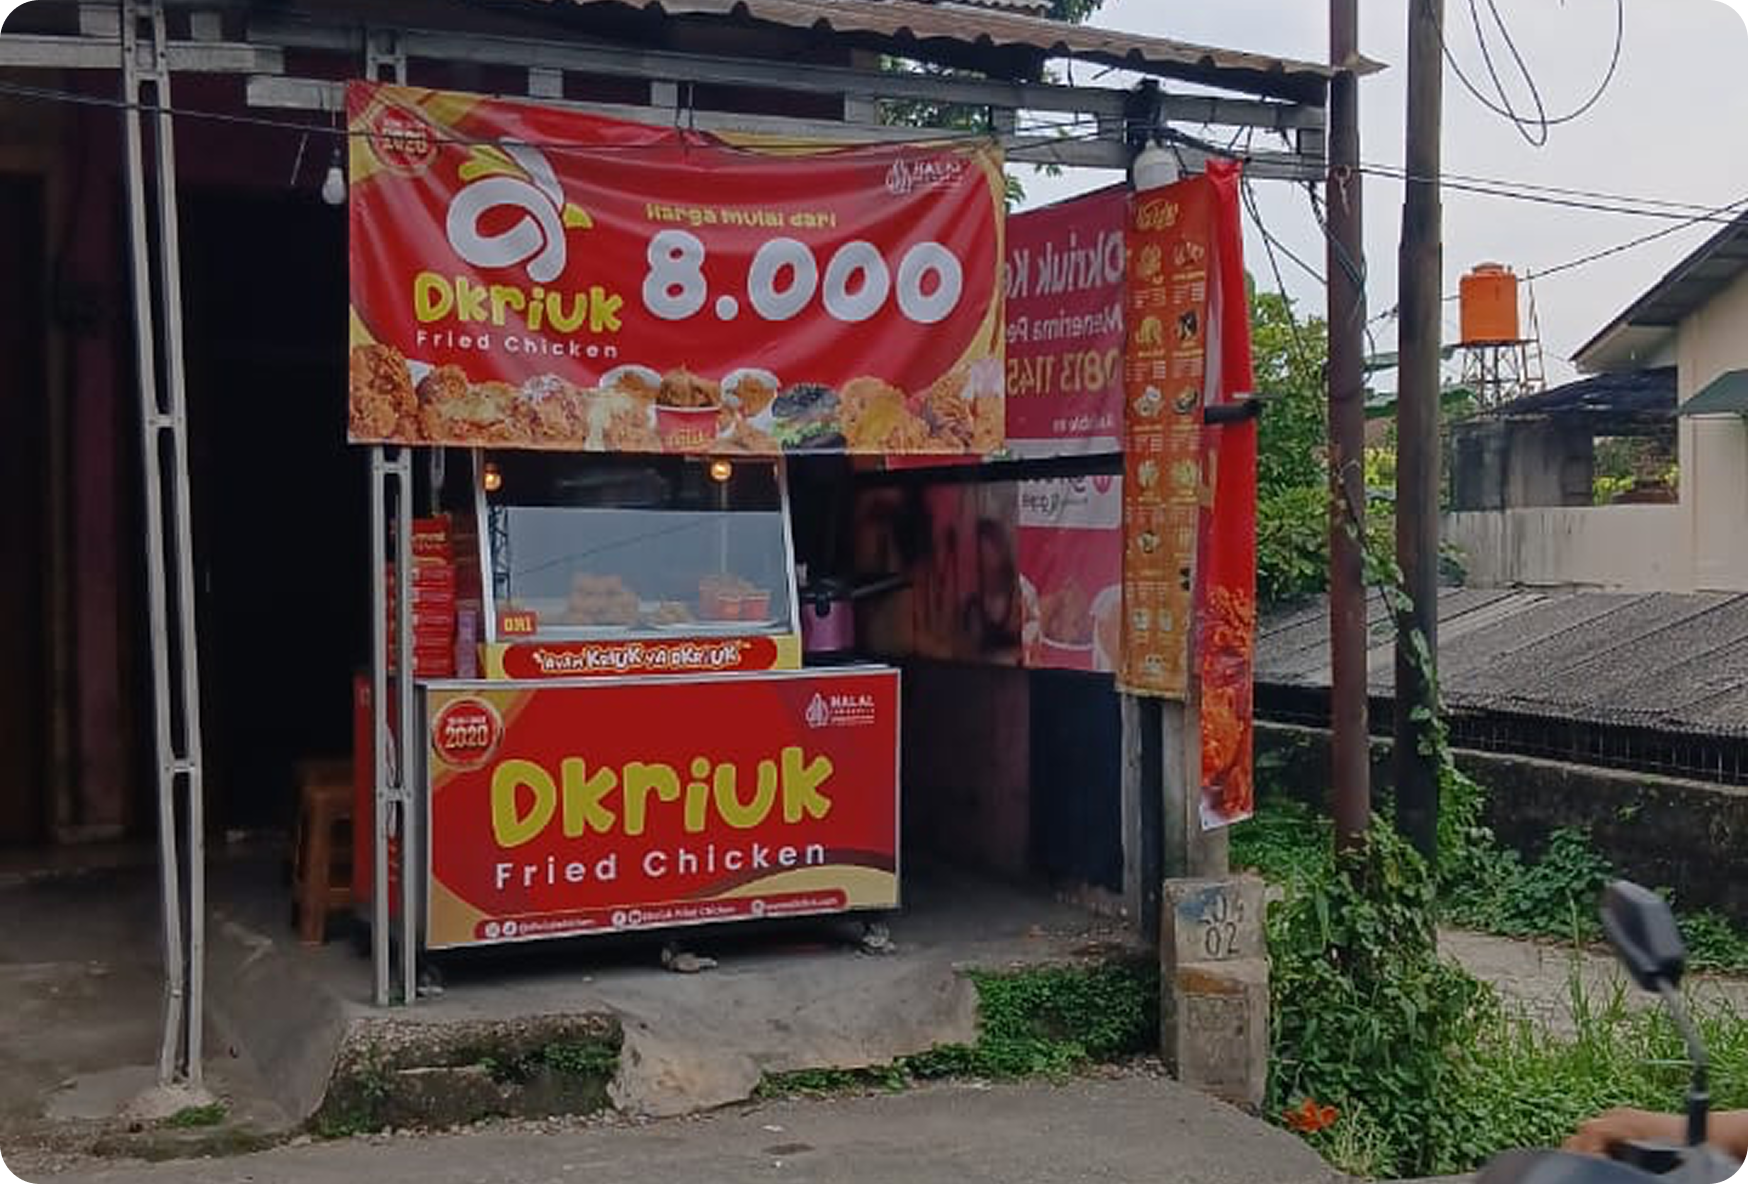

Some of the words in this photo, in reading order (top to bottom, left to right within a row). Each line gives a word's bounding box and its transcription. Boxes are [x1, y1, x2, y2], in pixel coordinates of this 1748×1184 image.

[646, 203, 717, 226] Harga
[721, 208, 784, 227] mulai
[789, 211, 837, 228] dari
[642, 229, 964, 323] 8.000
[416, 330, 490, 350] Fried
[504, 336, 619, 359] Chicken
[445, 724, 489, 749] 2020
[494, 854, 618, 890] Fried
[642, 843, 826, 879] Chicken
[1205, 921, 1240, 956] 02
